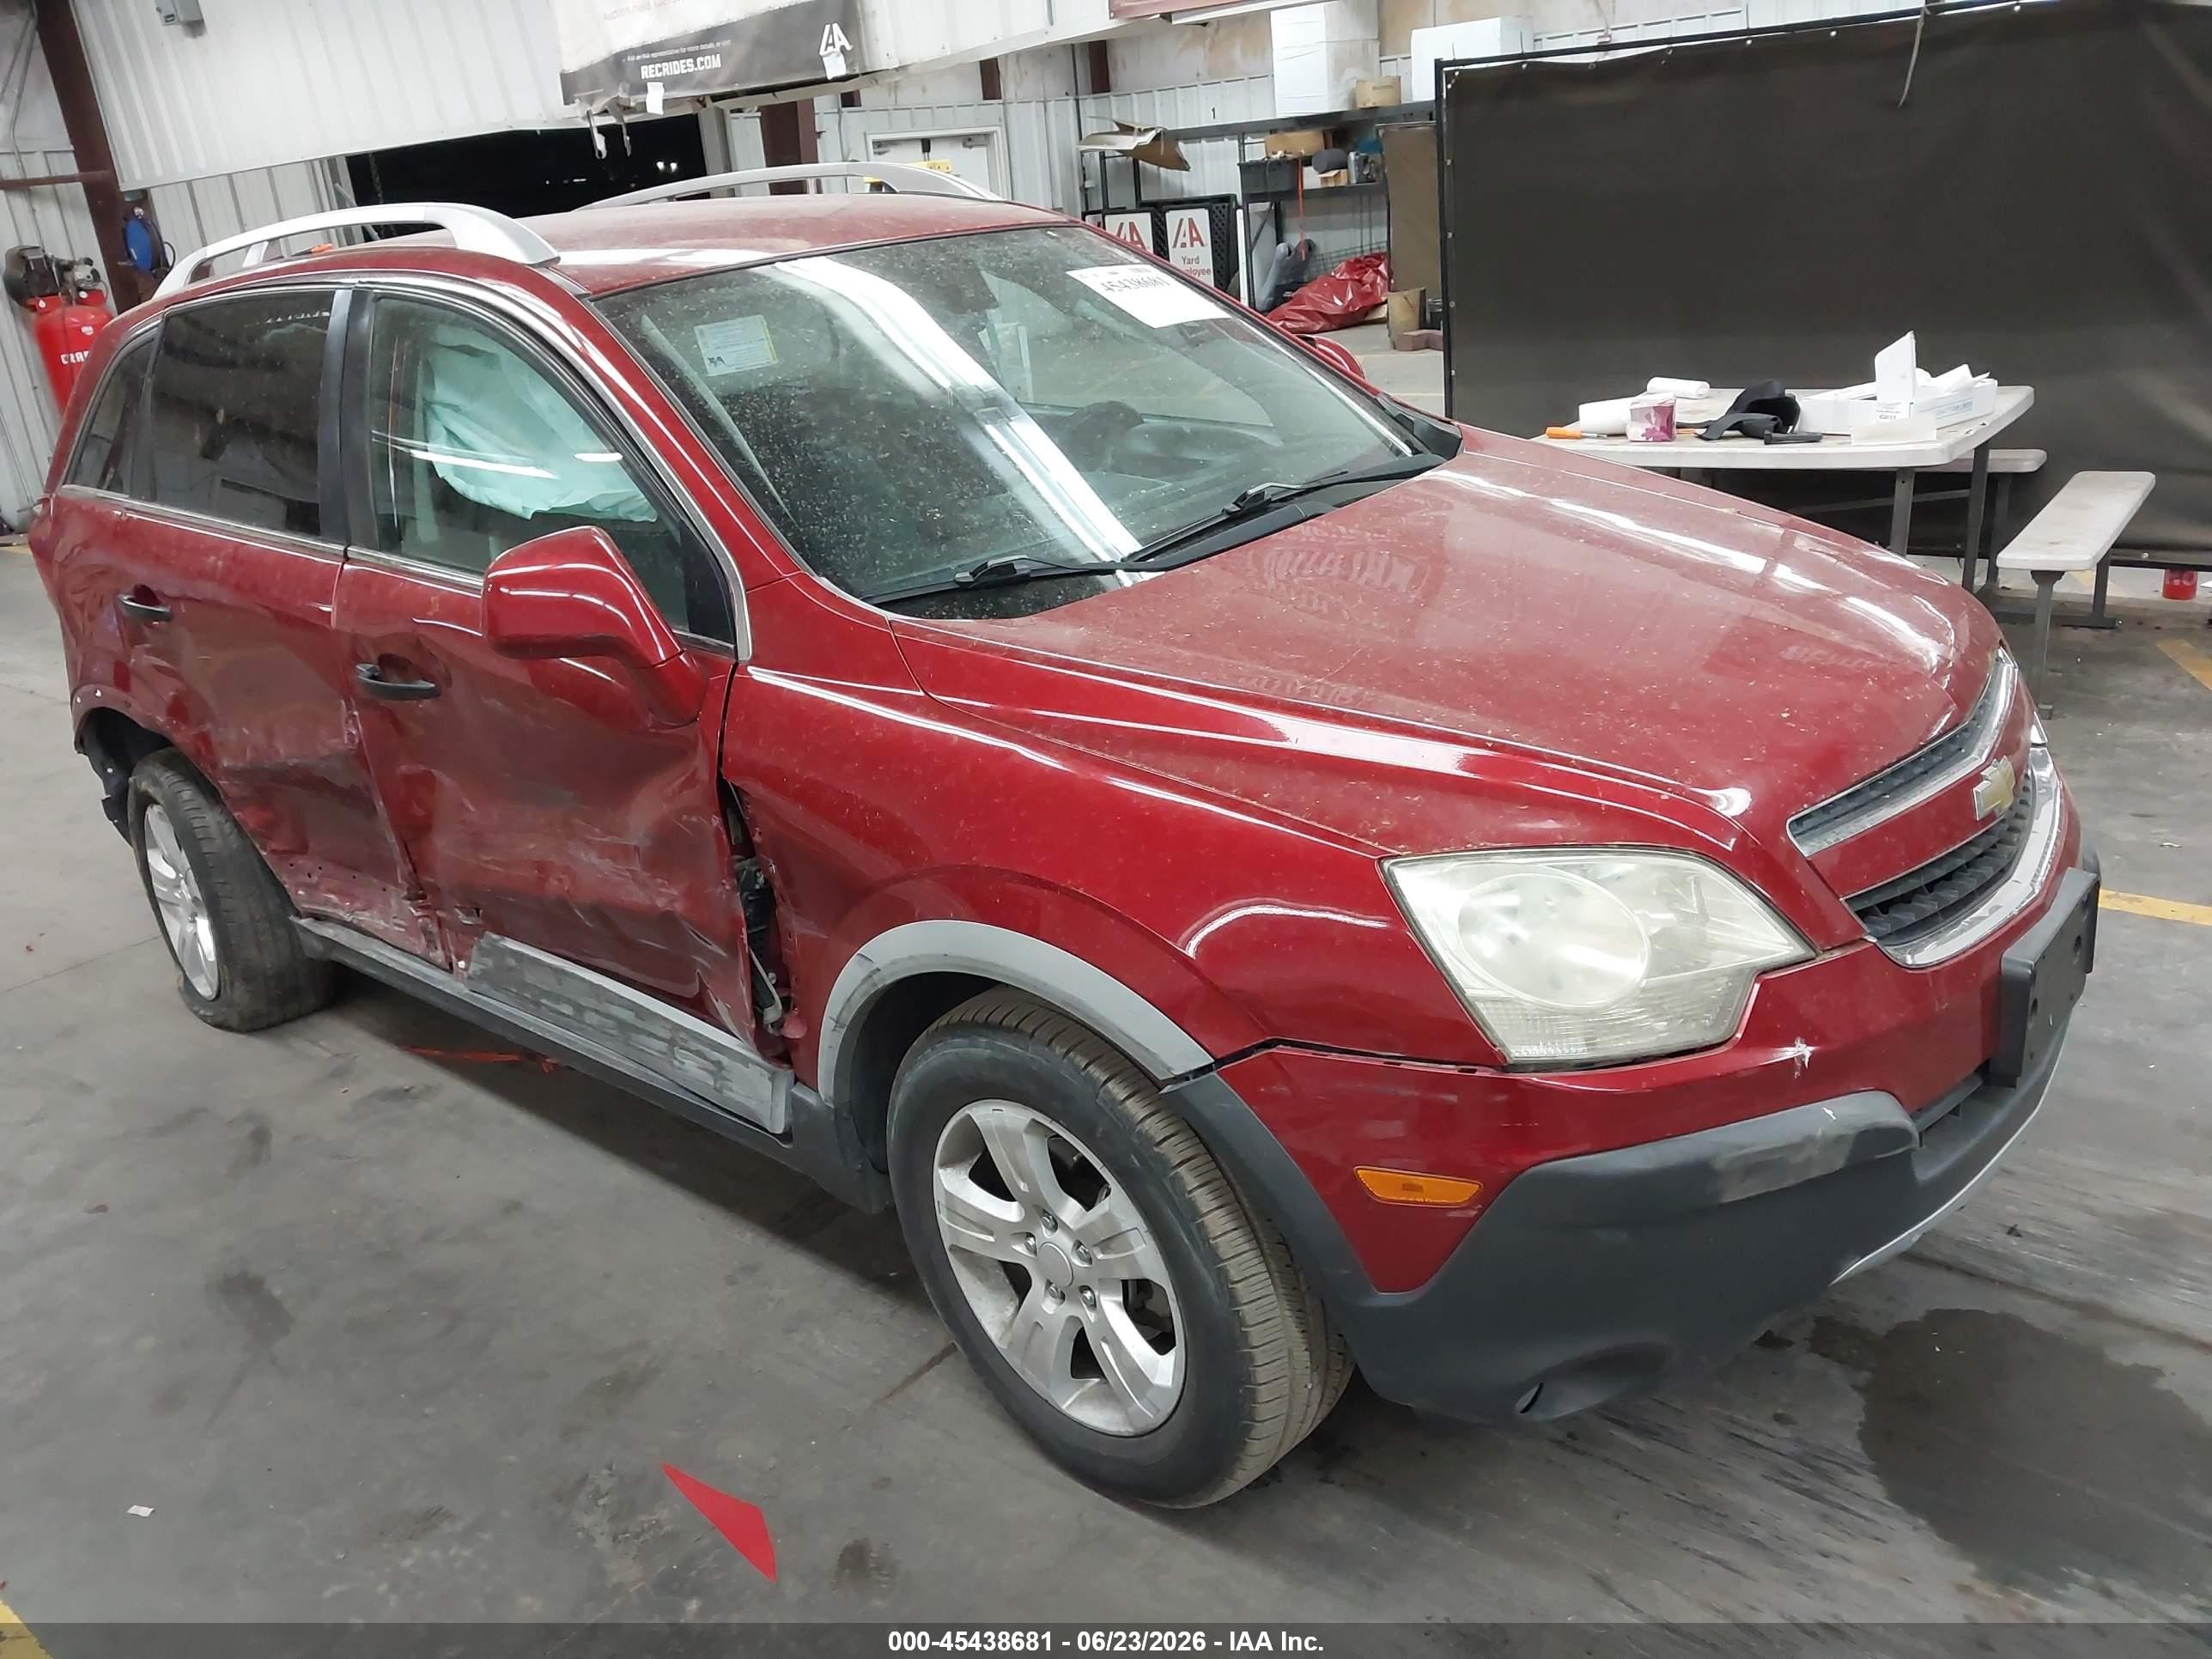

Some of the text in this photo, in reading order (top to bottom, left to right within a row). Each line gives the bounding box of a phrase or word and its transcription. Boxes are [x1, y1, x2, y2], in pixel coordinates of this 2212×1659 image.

[640, 53, 721, 80] RECRIDES.COM
[1181, 255, 1200, 265] Yard
[1100, 276, 1171, 293] 45438681
